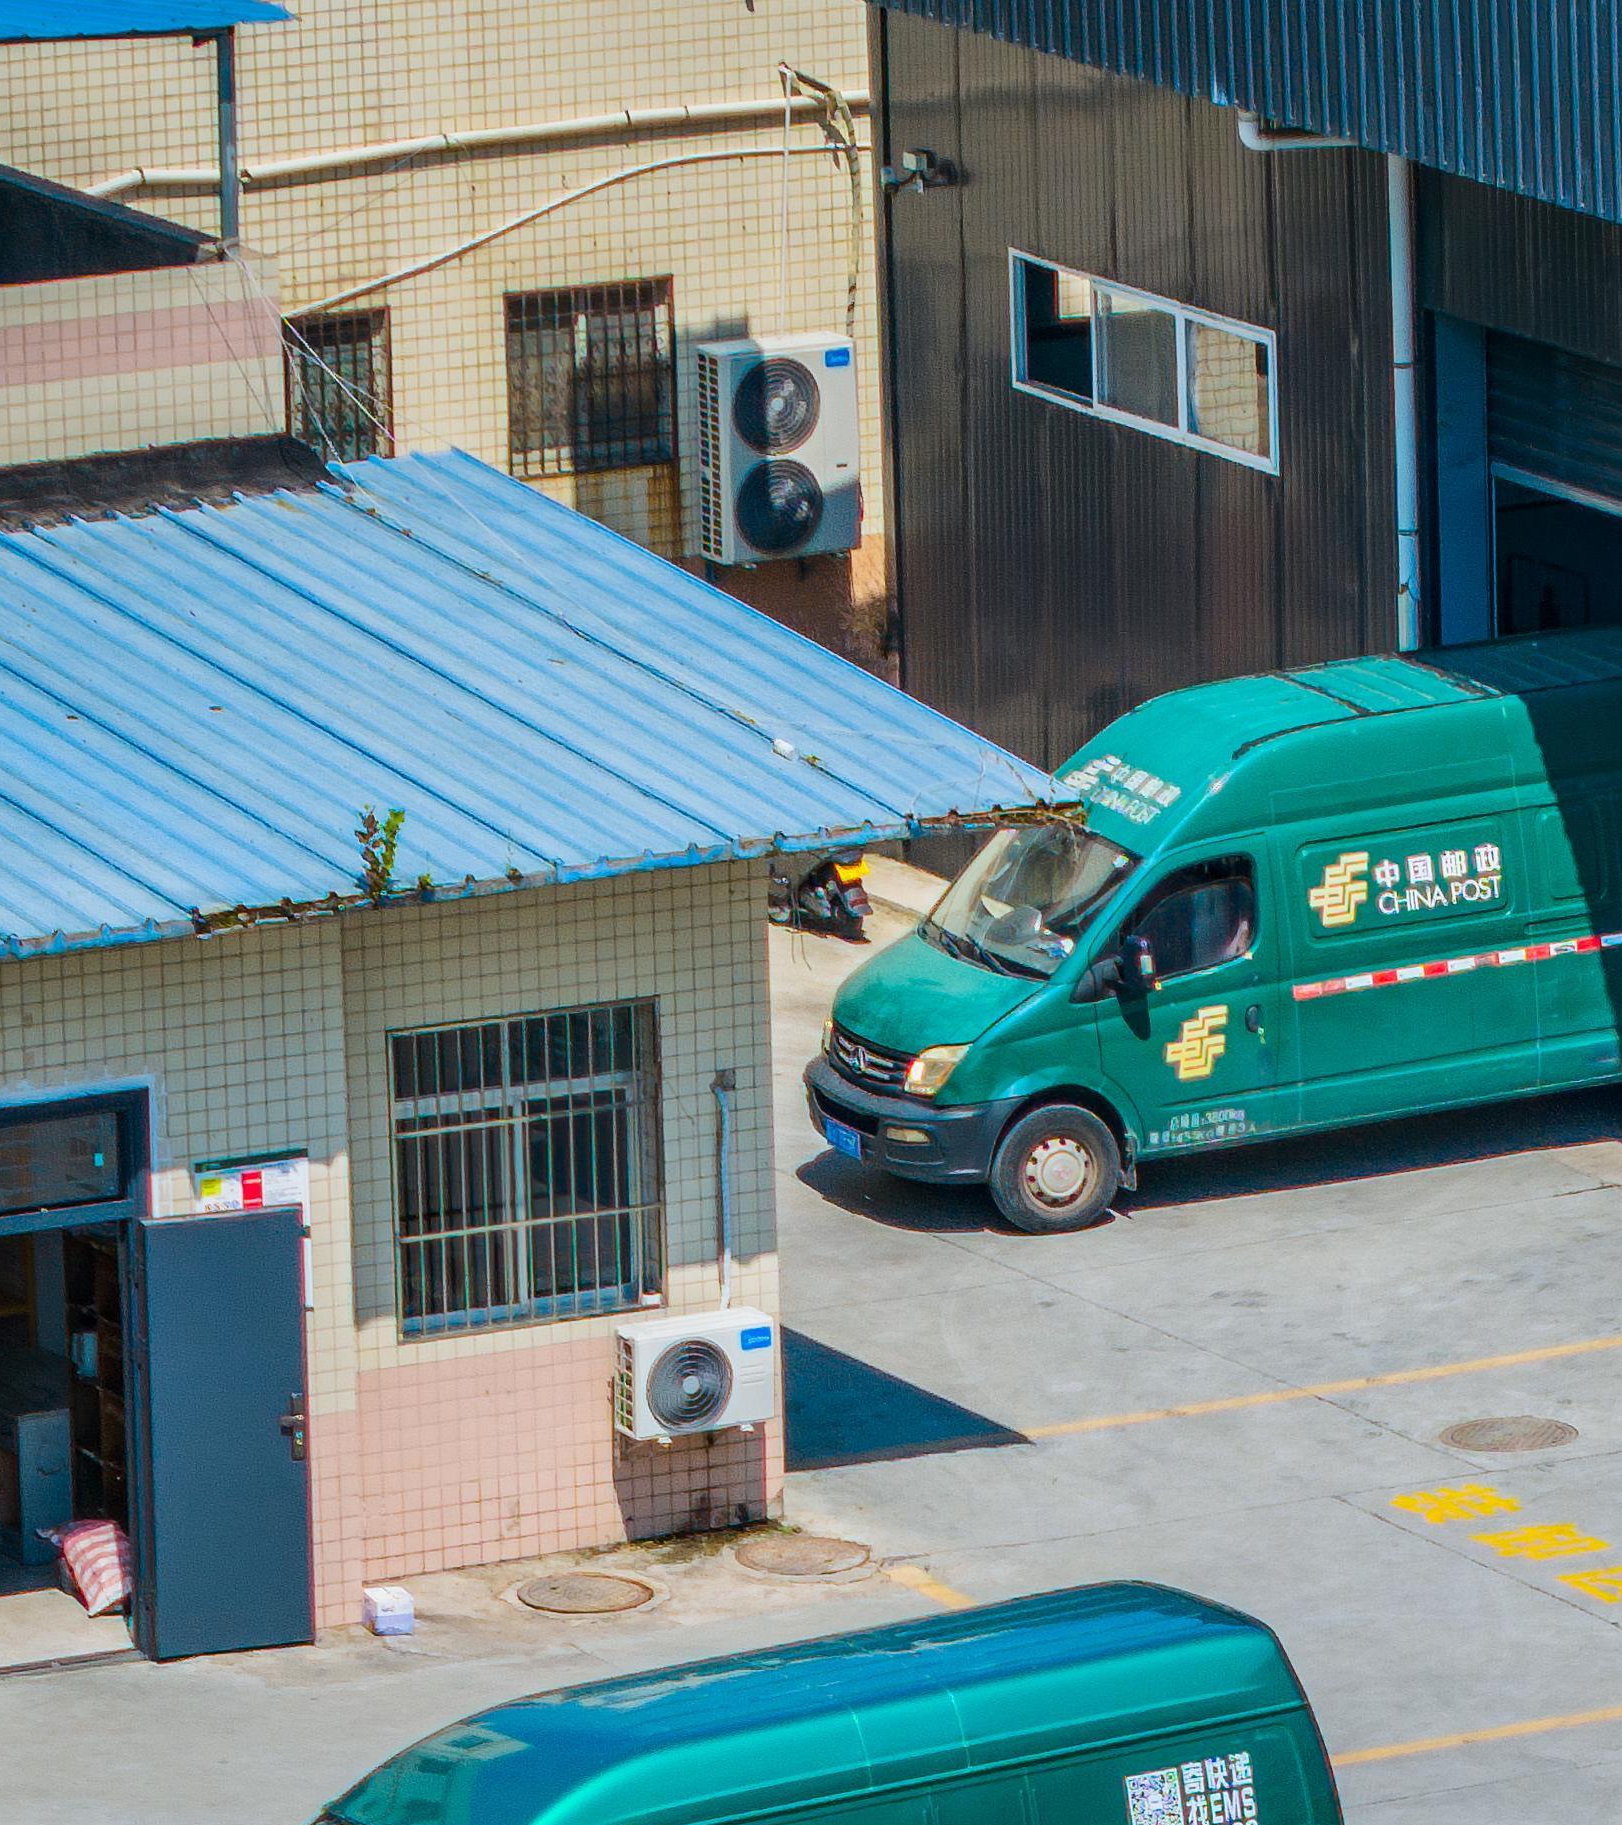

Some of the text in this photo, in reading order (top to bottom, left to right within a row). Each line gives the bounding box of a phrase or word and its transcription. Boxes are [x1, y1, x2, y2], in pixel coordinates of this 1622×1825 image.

[1373, 843, 1500, 888] 中国邮政
[1378, 875, 1501, 914] CHINA POST
[1181, 1751, 1253, 1794] 寄快递
